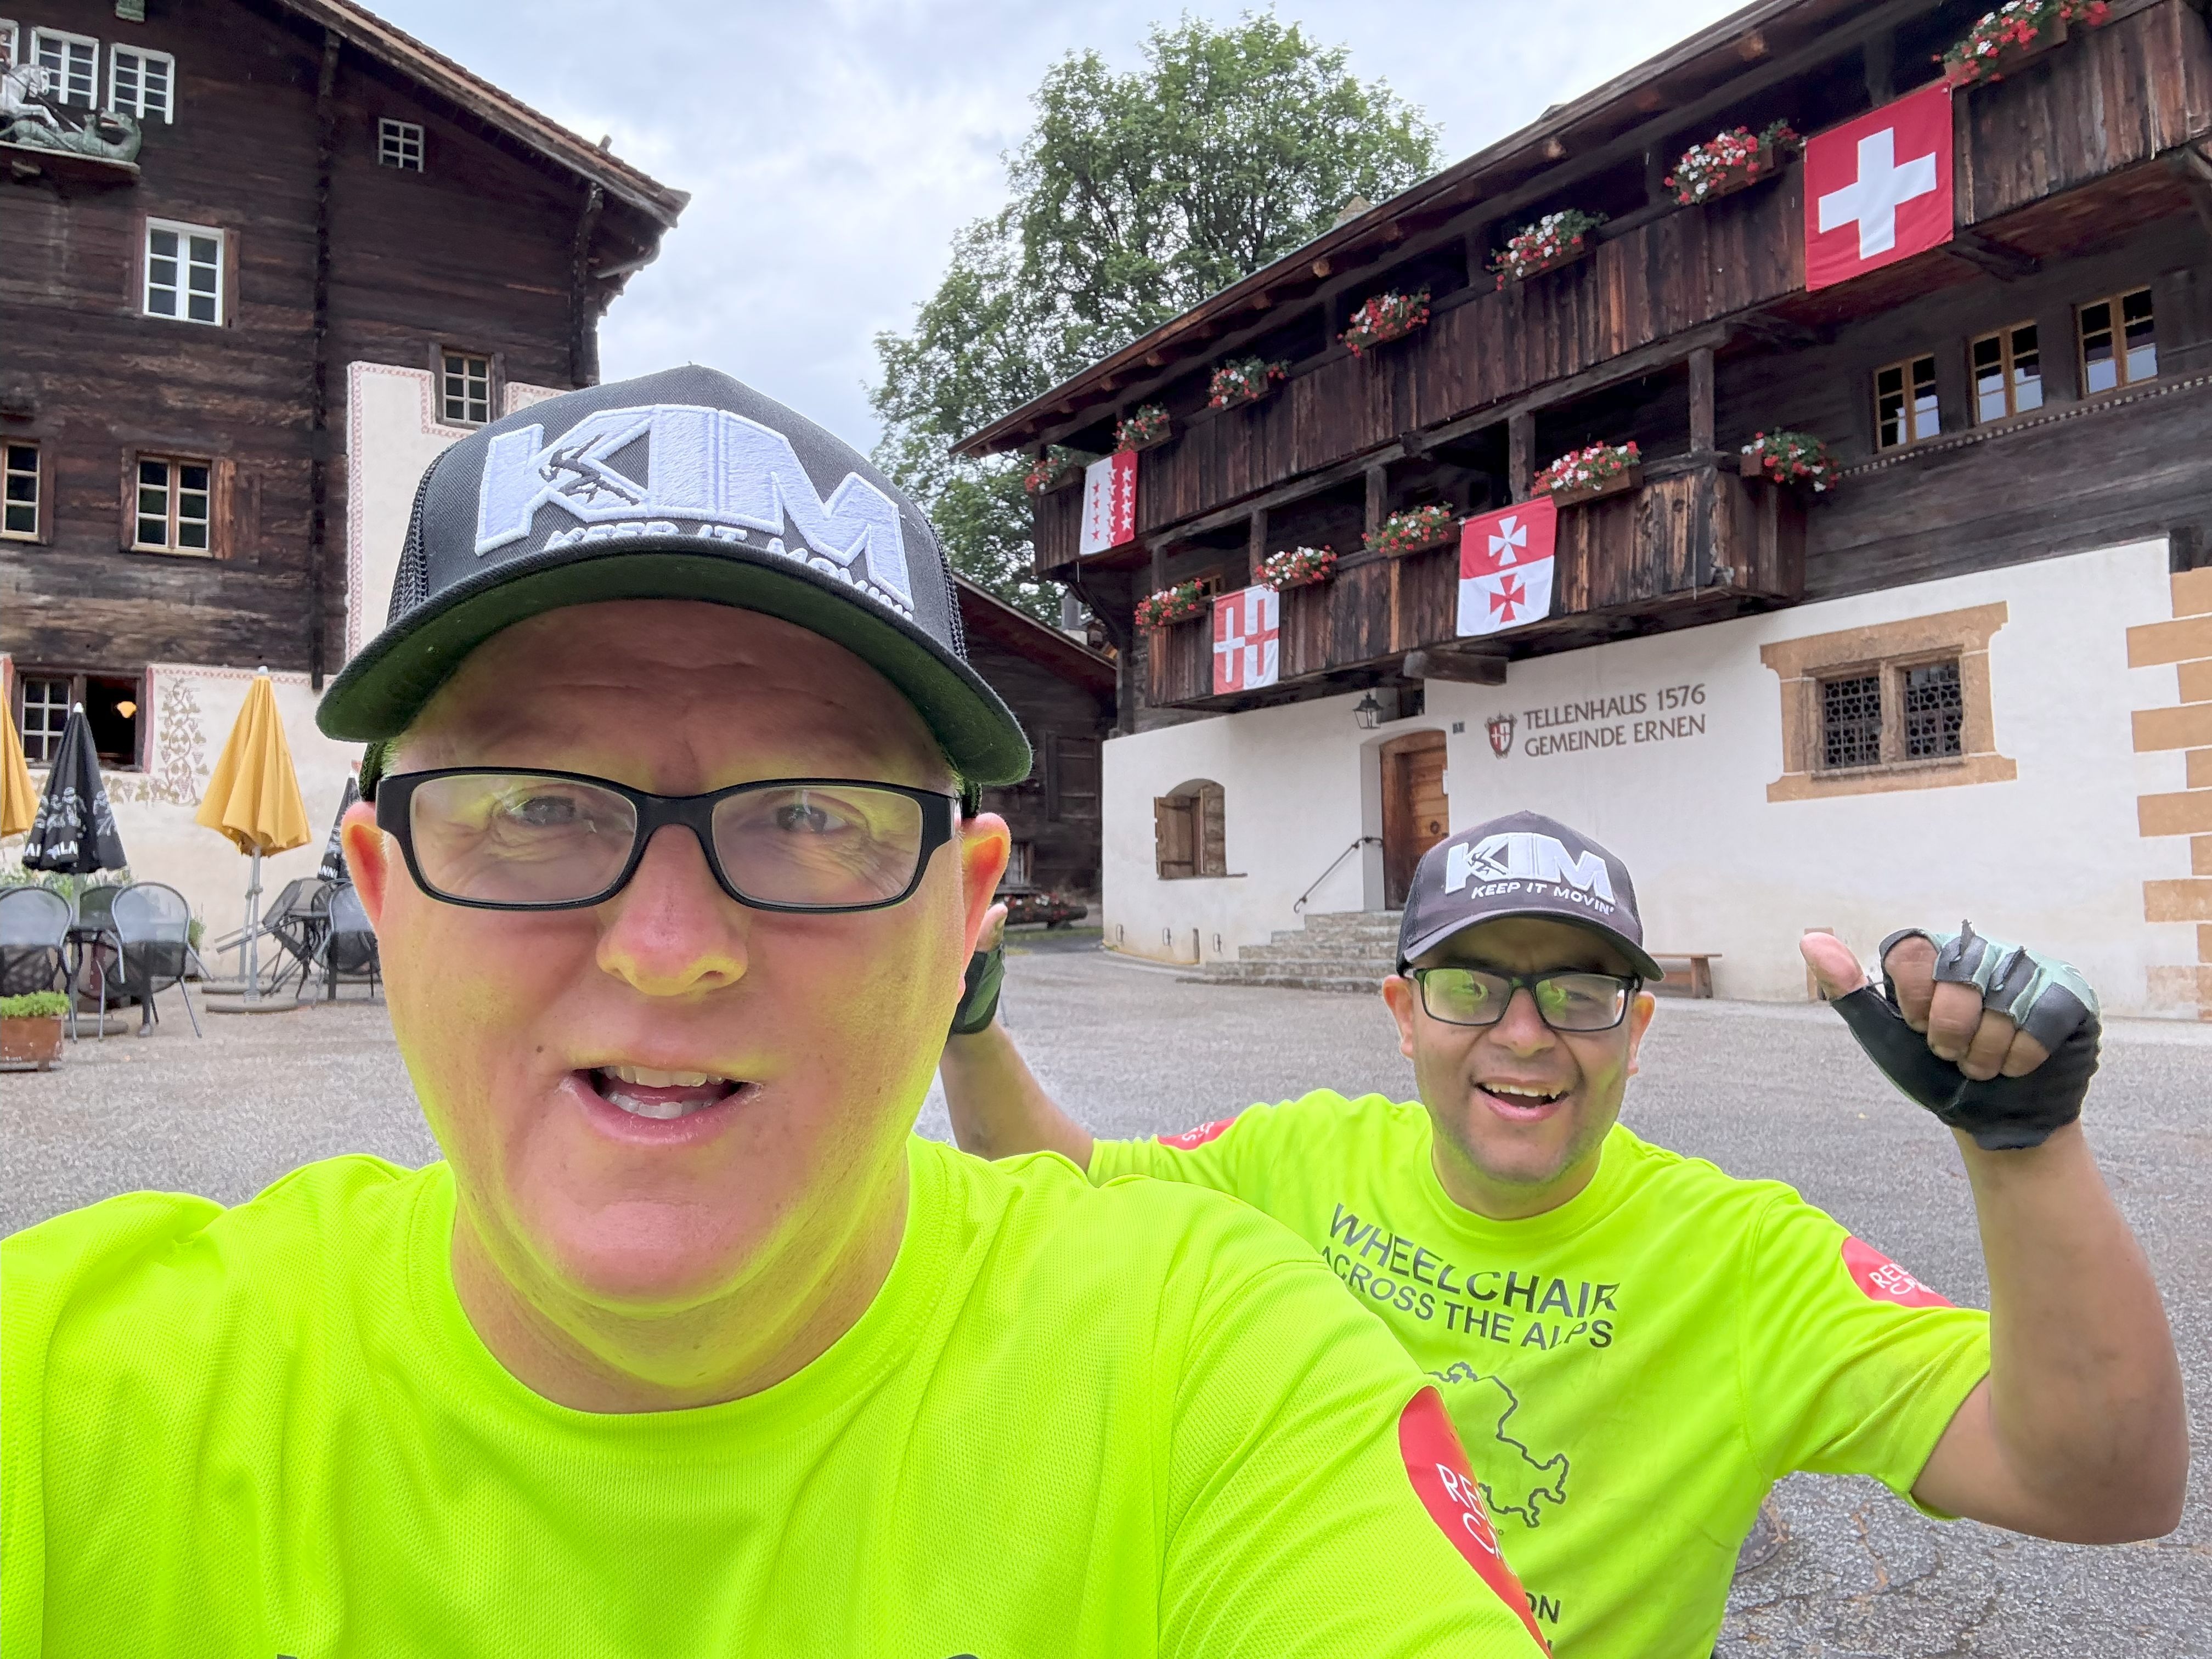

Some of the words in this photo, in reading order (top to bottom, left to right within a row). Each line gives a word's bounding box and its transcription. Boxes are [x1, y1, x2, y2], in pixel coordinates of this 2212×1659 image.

[475, 404, 915, 611] KIM
[1523, 692, 1647, 730] TELLENHAUS
[1657, 682, 1706, 711] 1576
[1524, 724, 1627, 758] GEMEINDE
[1634, 714, 1706, 743] ERNEN
[1445, 832, 1616, 905] KIM
[1471, 882, 1521, 900] KEEP
[1526, 882, 1548, 894] IT
[1554, 886, 1614, 916] MOVIN'
[1329, 1203, 1620, 1318] WHEELCHAIR
[1443, 1300, 1515, 1344] THE
[1520, 1319, 1613, 1350] ALPS
